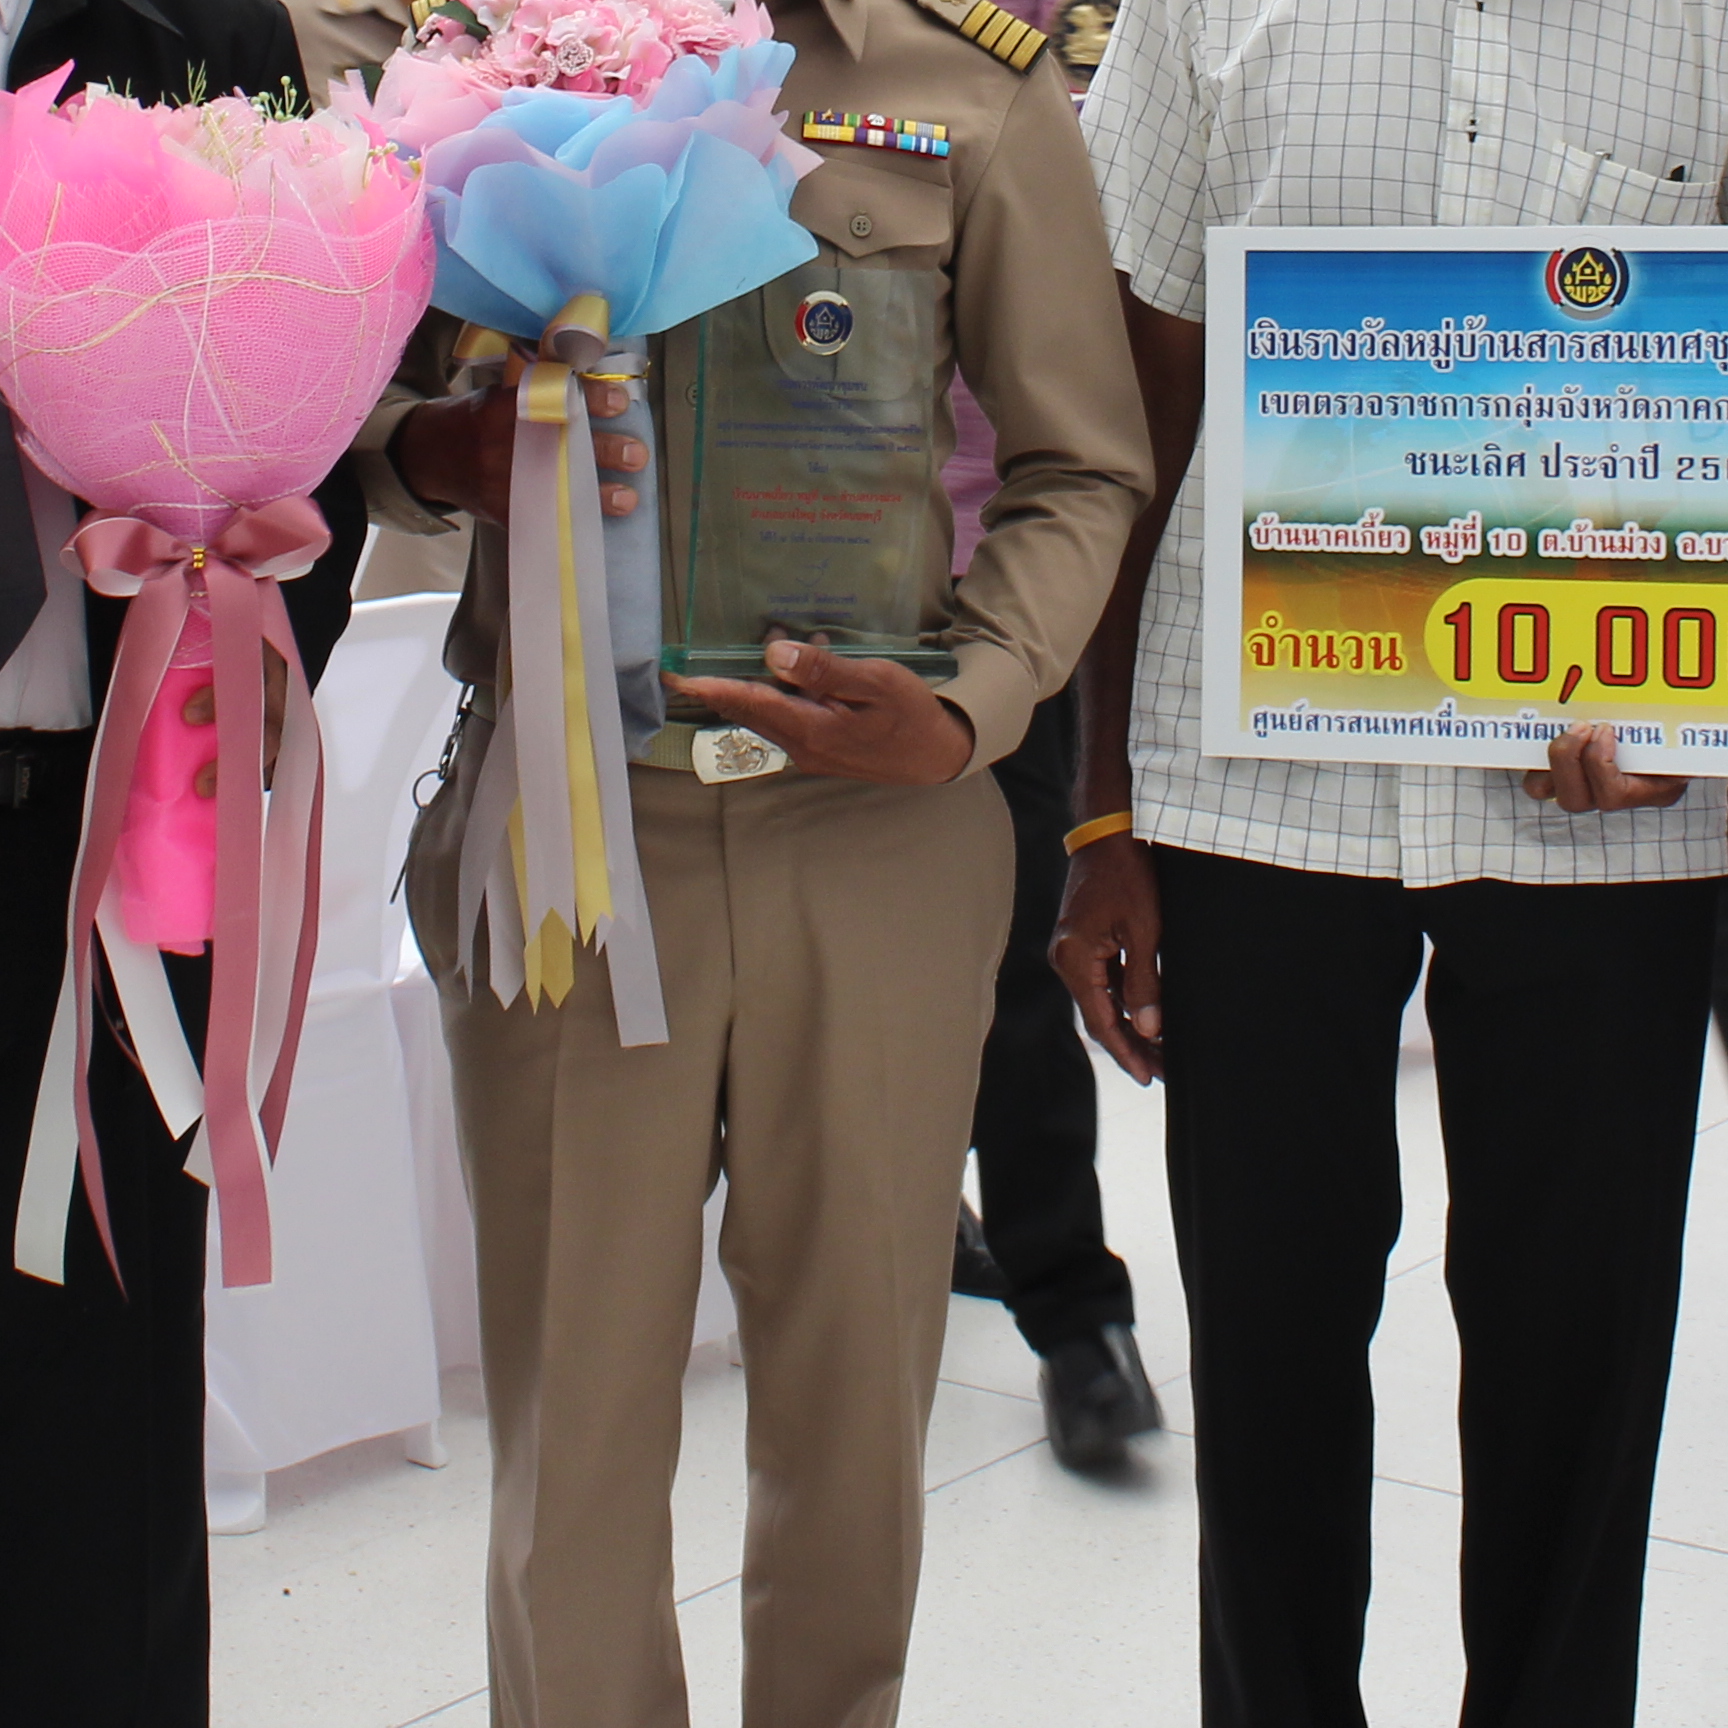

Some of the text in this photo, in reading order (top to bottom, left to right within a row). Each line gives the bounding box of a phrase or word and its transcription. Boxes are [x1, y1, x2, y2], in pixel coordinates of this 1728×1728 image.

[1404, 443, 1525, 477] ชนะเลิศ
[1541, 441, 1659, 480] ประจำปี
[1253, 512, 1406, 550] บ้านนาคเกี้ยว
[1425, 513, 1477, 558] หมู่ที่
[1491, 531, 1522, 552] 10
[1542, 521, 1662, 555] ต.บ้านม่วง
[1248, 614, 1404, 672] จำนวน
